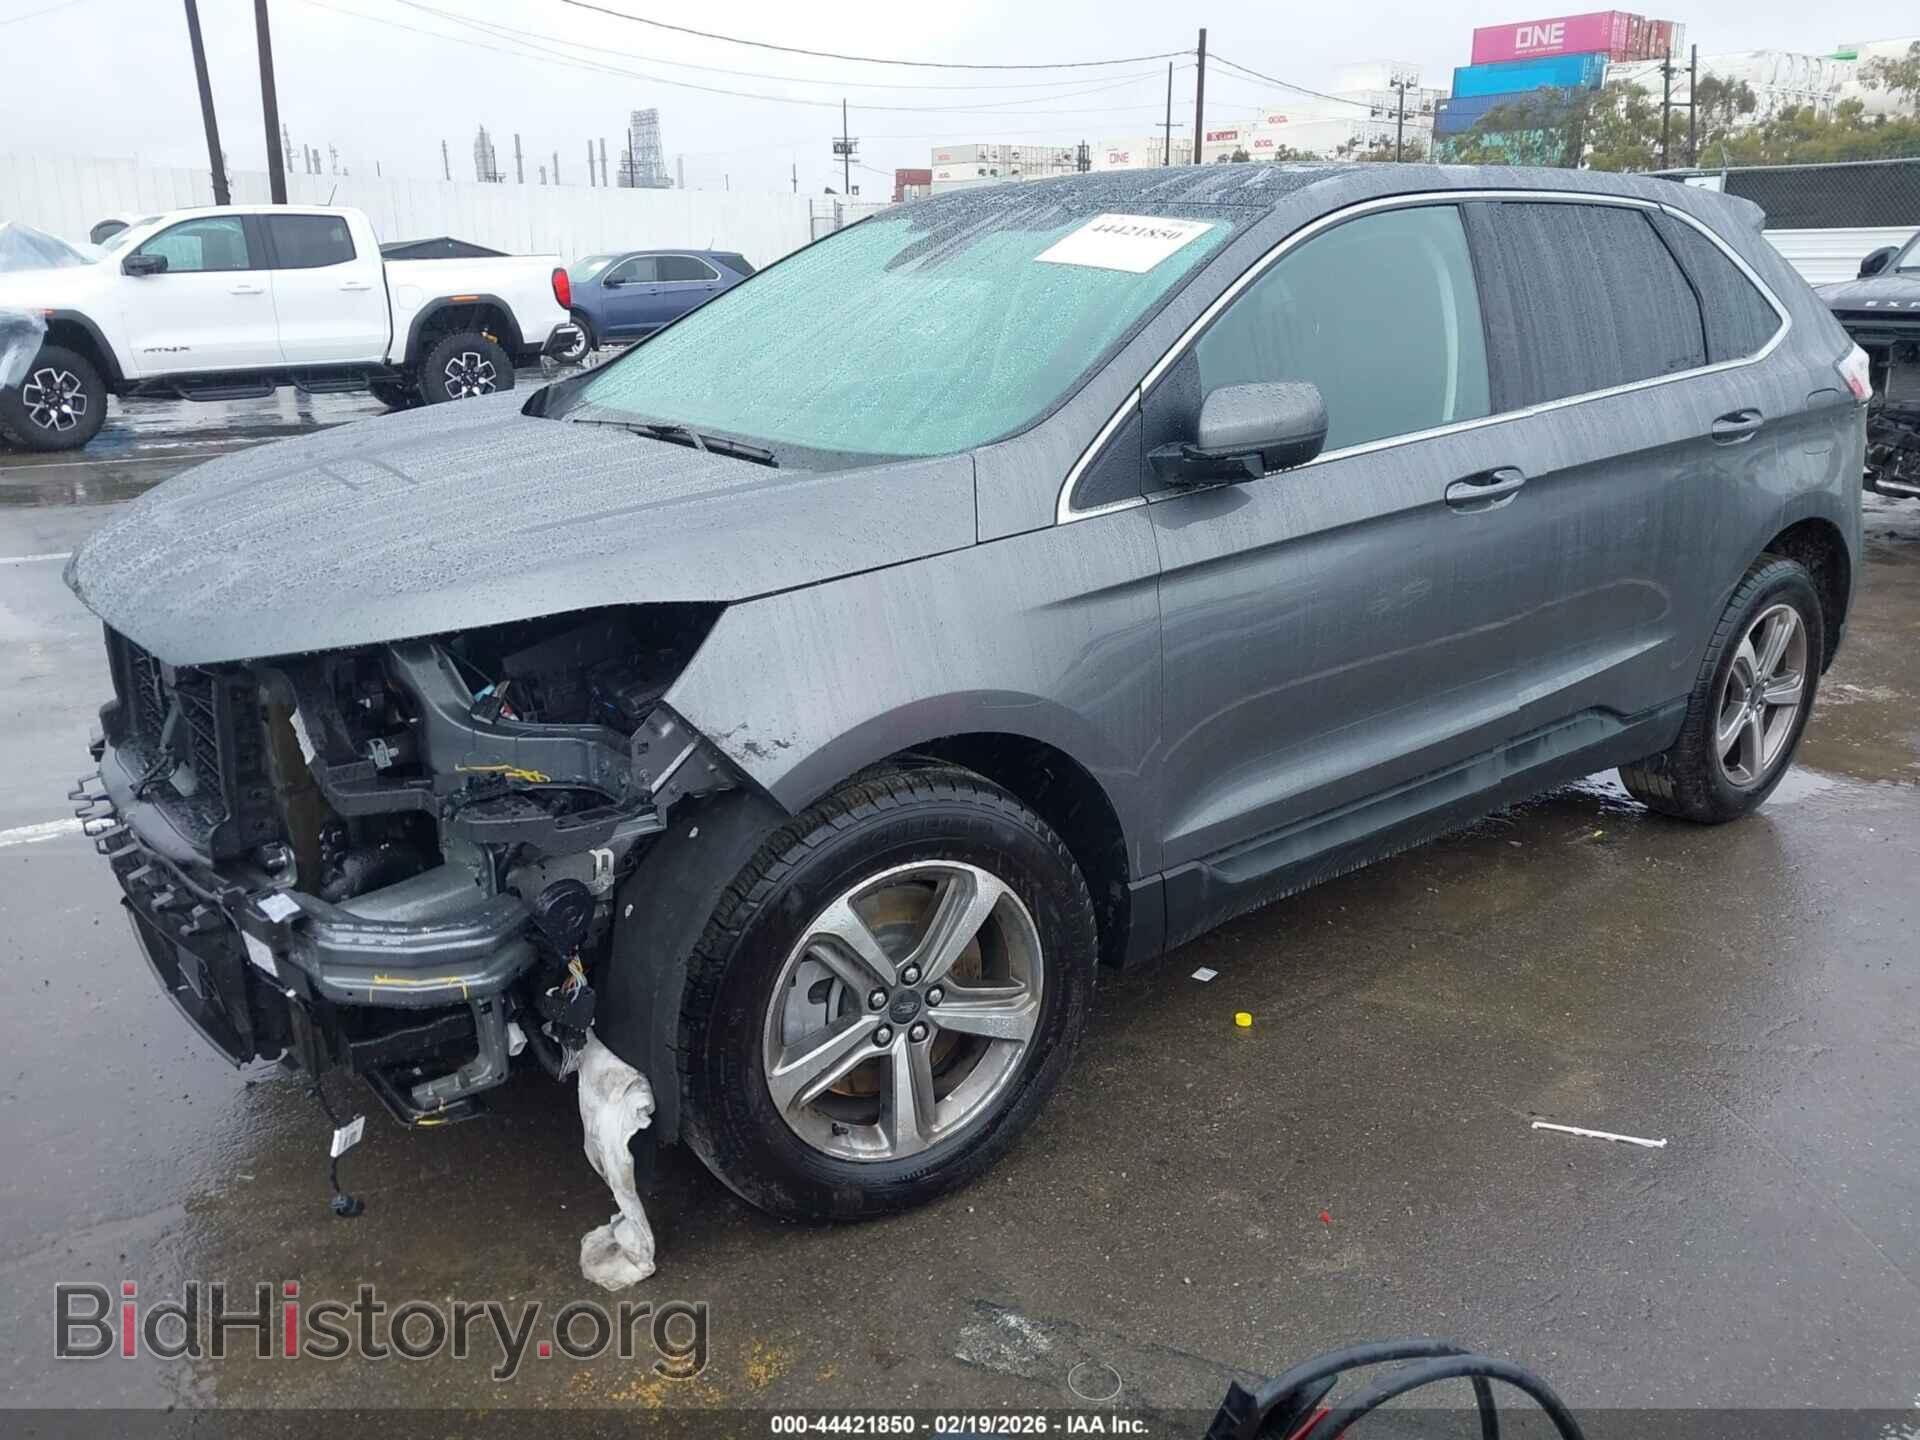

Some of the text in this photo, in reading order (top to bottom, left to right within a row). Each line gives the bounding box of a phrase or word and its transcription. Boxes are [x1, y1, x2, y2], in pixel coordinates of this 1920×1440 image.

[1515, 22, 1566, 49] ONE
[1108, 152, 1129, 164] ONE
[1092, 223, 1184, 241] 44421850
